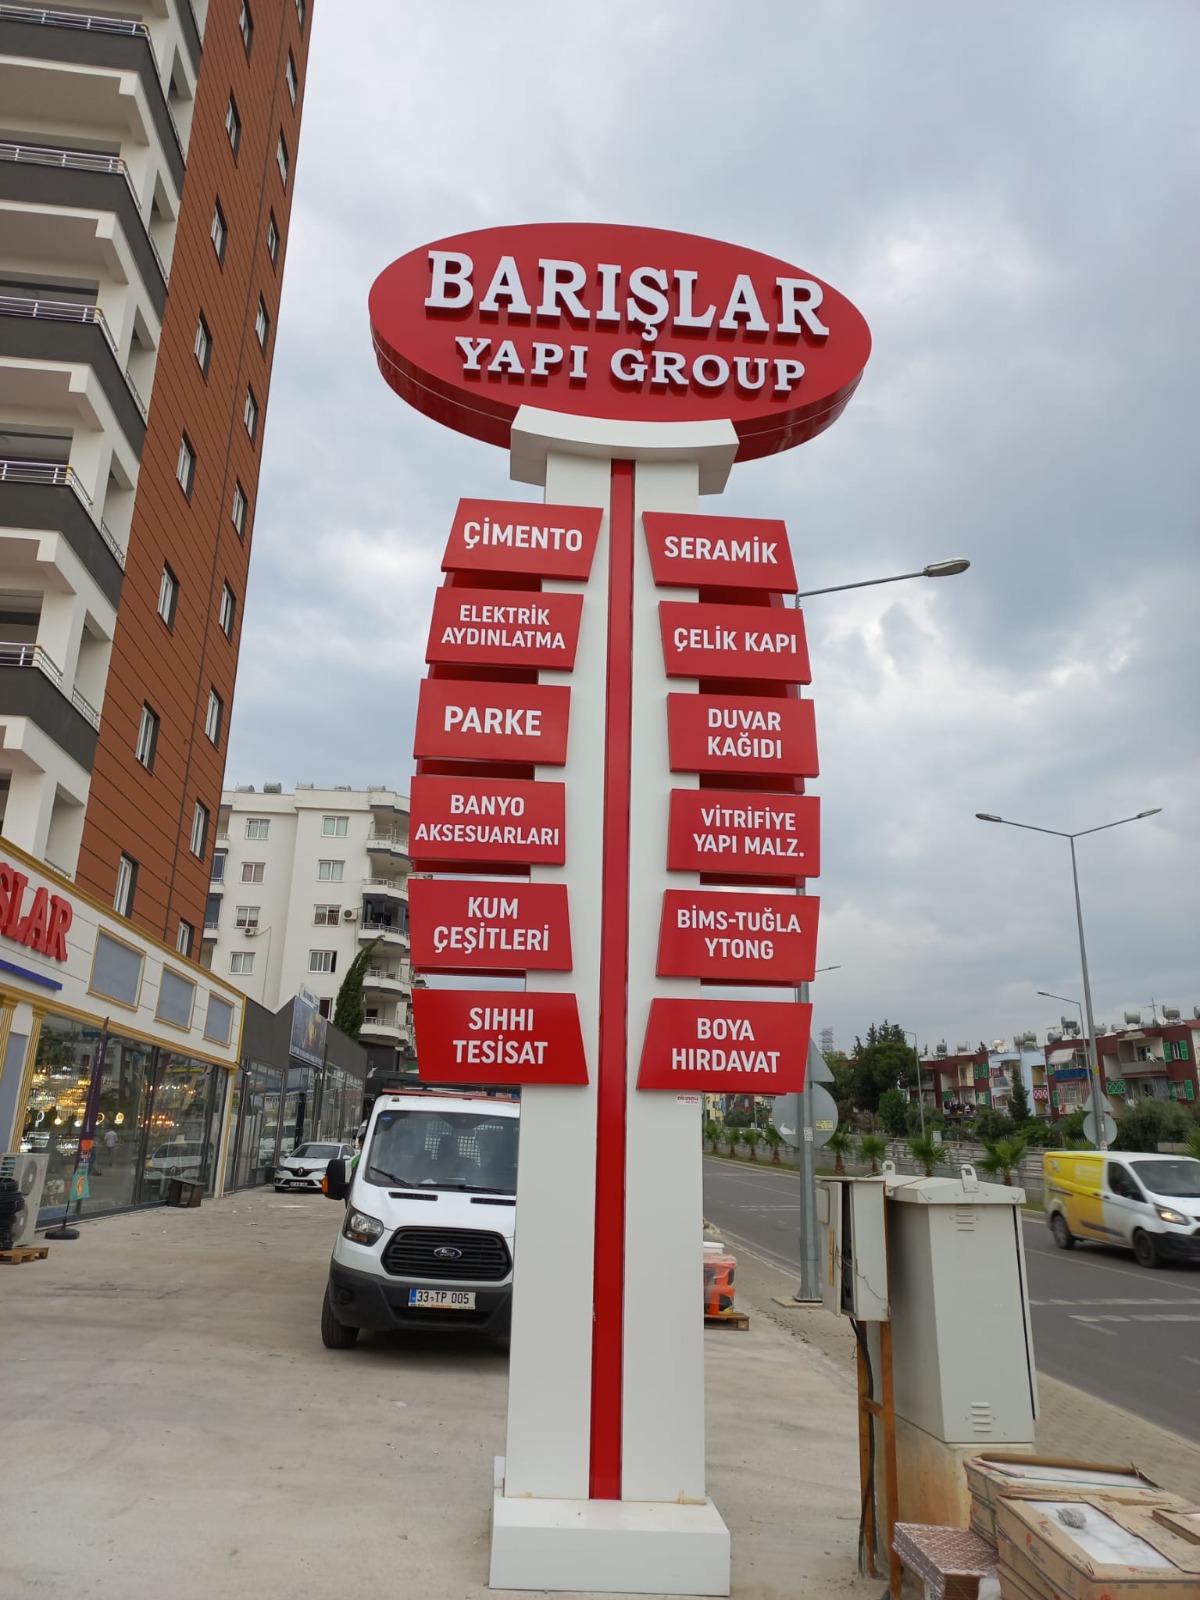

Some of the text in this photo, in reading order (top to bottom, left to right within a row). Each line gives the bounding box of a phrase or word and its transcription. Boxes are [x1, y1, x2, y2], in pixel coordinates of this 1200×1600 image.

[424, 249, 830, 342] BARIŞLAR
[454, 336, 806, 391] YAPI GROUP
[463, 517, 583, 552] ÇİMENTO
[664, 535, 778, 564] SERAMİK
[459, 604, 550, 626] ELEKTRİK
[441, 628, 566, 650] AYDINLATMA
[673, 625, 797, 654] ÇELİK KAPI
[444, 705, 542, 737] PARKE
[708, 708, 782, 732] DUVAR
[707, 733, 782, 759] KAĞIDI
[450, 794, 525, 817] BANYO
[700, 804, 796, 832] VİTRİFİYE
[415, 823, 559, 846] AKSESUARLARI
[692, 834, 805, 858] YAPI MALZ.
[467, 896, 519, 920] KUM
[677, 904, 802, 934] BİMS-TUĞLA
[433, 922, 549, 954] ÇEŞİTLERİ
[704, 937, 774, 960] YTONG
[468, 1007, 534, 1031] SIHHI
[697, 1017, 755, 1041] BOYA
[453, 1034, 548, 1065] TESİSAT
[672, 1047, 781, 1074] HIRDAVAT
[417, 1291, 469, 1304] 33 TP 005
